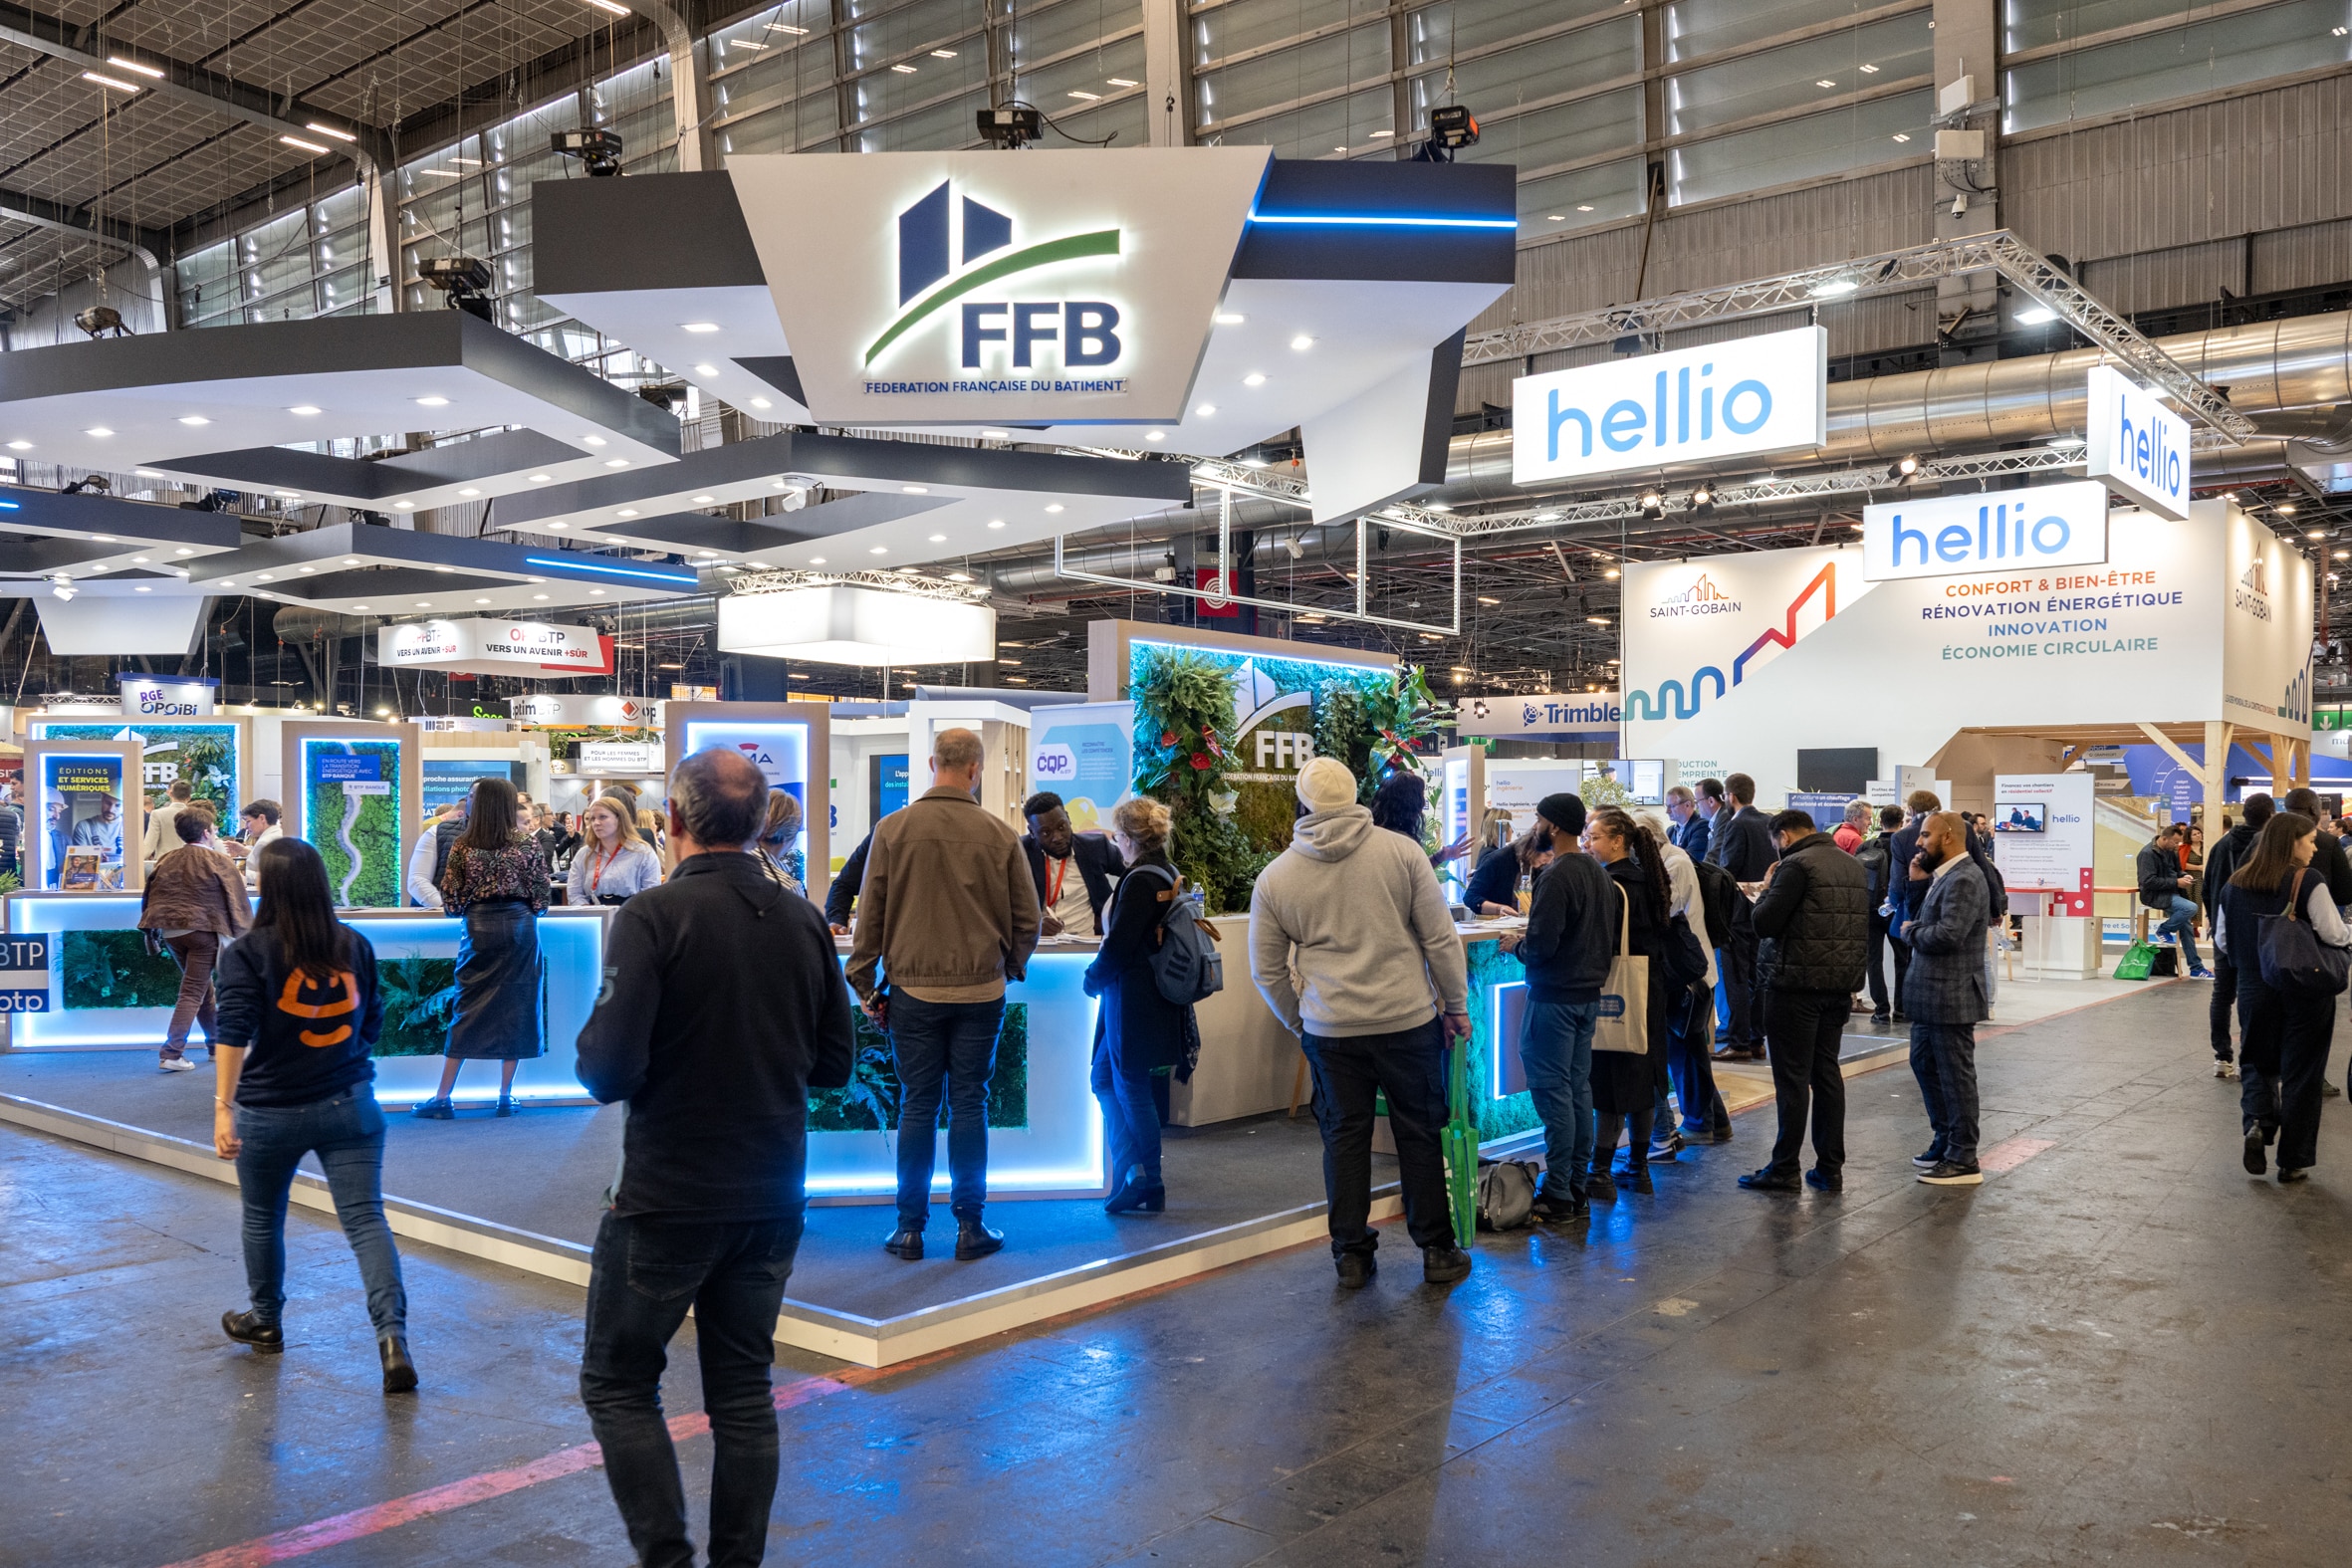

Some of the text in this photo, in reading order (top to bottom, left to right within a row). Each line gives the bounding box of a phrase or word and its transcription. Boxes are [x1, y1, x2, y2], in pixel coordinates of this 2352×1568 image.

[962, 302, 1121, 367] FFB
[866, 380, 1122, 394] FEDERATION FRANÇAISE DU BATIMENT
[1548, 362, 1772, 462] hellio
[2121, 394, 2180, 497] hellio
[1892, 503, 2071, 567] hellio
[1946, 570, 2156, 597] CONFORT & BIEN-ÊTRE
[1650, 601, 1742, 618] SAINT-GOBAIN
[1922, 591, 2183, 619] RÉNOVATION ÉNERGÉTIQUE
[2235, 588, 2272, 623] SAINT-GOBAIN
[510, 628, 566, 644] OBTP
[1989, 618, 2107, 637] INNOVATION
[396, 648, 411, 657] VERS
[421, 646, 440, 656] AVENIR
[486, 644, 588, 658] VERS UN AVENIR +SÛR
[1942, 637, 2158, 660] ÉCONOMIE CIRCULAIRE
[140, 689, 163, 702] RGE
[1543, 702, 1620, 724] Trimble
[1256, 730, 1315, 770] FFB
[0, 769, 14, 778] SI
[143, 762, 179, 784] FB
[1037, 755, 1067, 775] CQP
[56, 784, 111, 792] NUMÉRIQUES
[1253, 774, 1280, 783] FRANÇAISE
[2052, 814, 2080, 823] hellio
